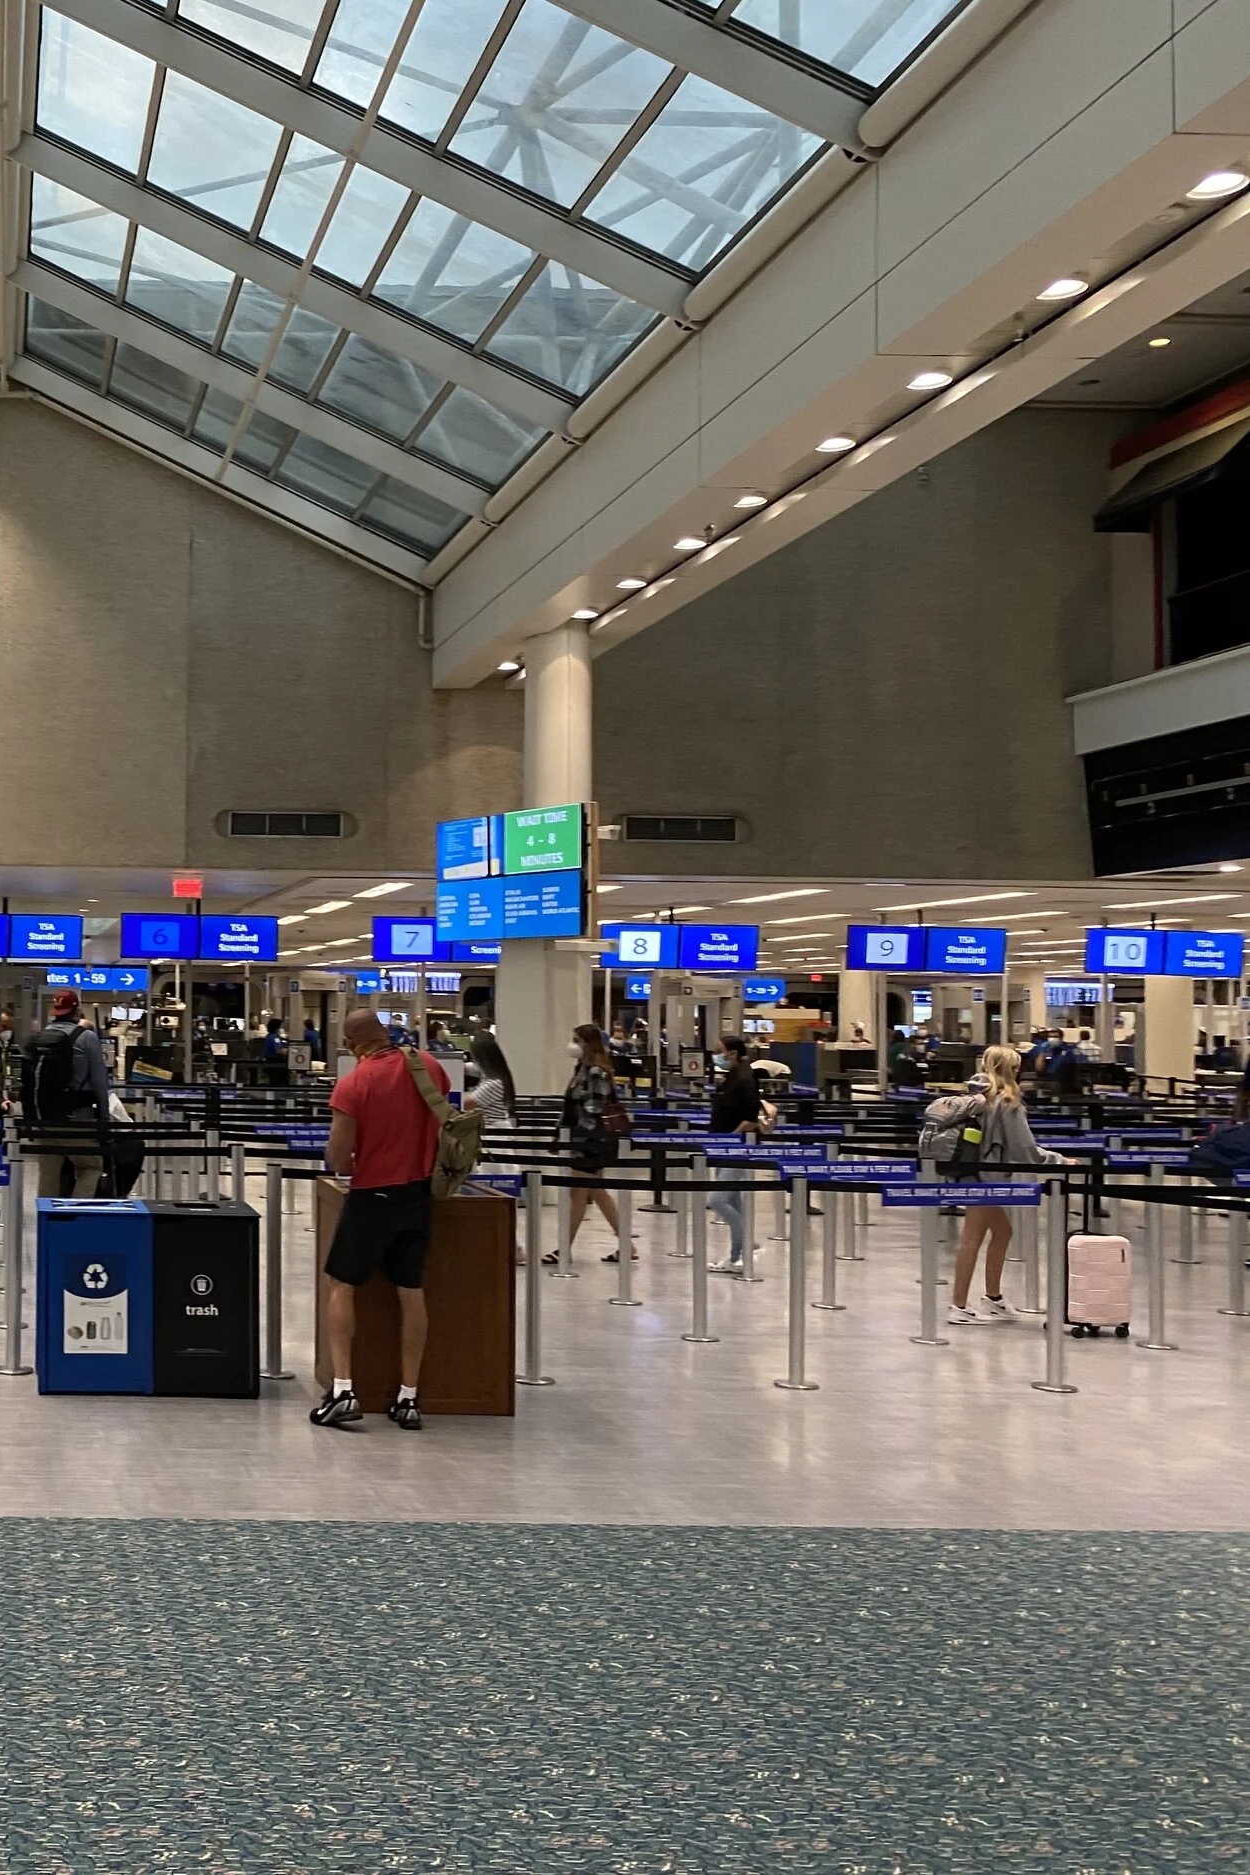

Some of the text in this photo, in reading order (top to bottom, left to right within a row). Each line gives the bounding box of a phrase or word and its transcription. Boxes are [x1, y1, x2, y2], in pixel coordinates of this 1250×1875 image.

[526, 835, 534, 846] 4
[38, 923, 55, 931] TSA
[230, 923, 248, 932] TSA
[29, 933, 64, 941] Standard
[153, 928, 168, 945] 6
[220, 933, 259, 942] Standard
[406, 931, 419, 949] 7
[710, 933, 729, 941] TSA
[958, 936, 976, 944] TSA
[27, 942, 65, 952] Screening
[218, 944, 259, 954] Screening
[633, 937, 648, 954] 8
[700, 943, 738, 951] Standard
[880, 940, 894, 957] 9
[1196, 940, 1215, 948] TSA
[947, 945, 986, 954] Standard
[1110, 941, 1141, 960] 10
[1185, 950, 1225, 958] Standard
[698, 953, 739, 963] Screening
[945, 956, 987, 966] Screening
[1183, 960, 1225, 970] Screening
[185, 1303, 219, 1316] trash
